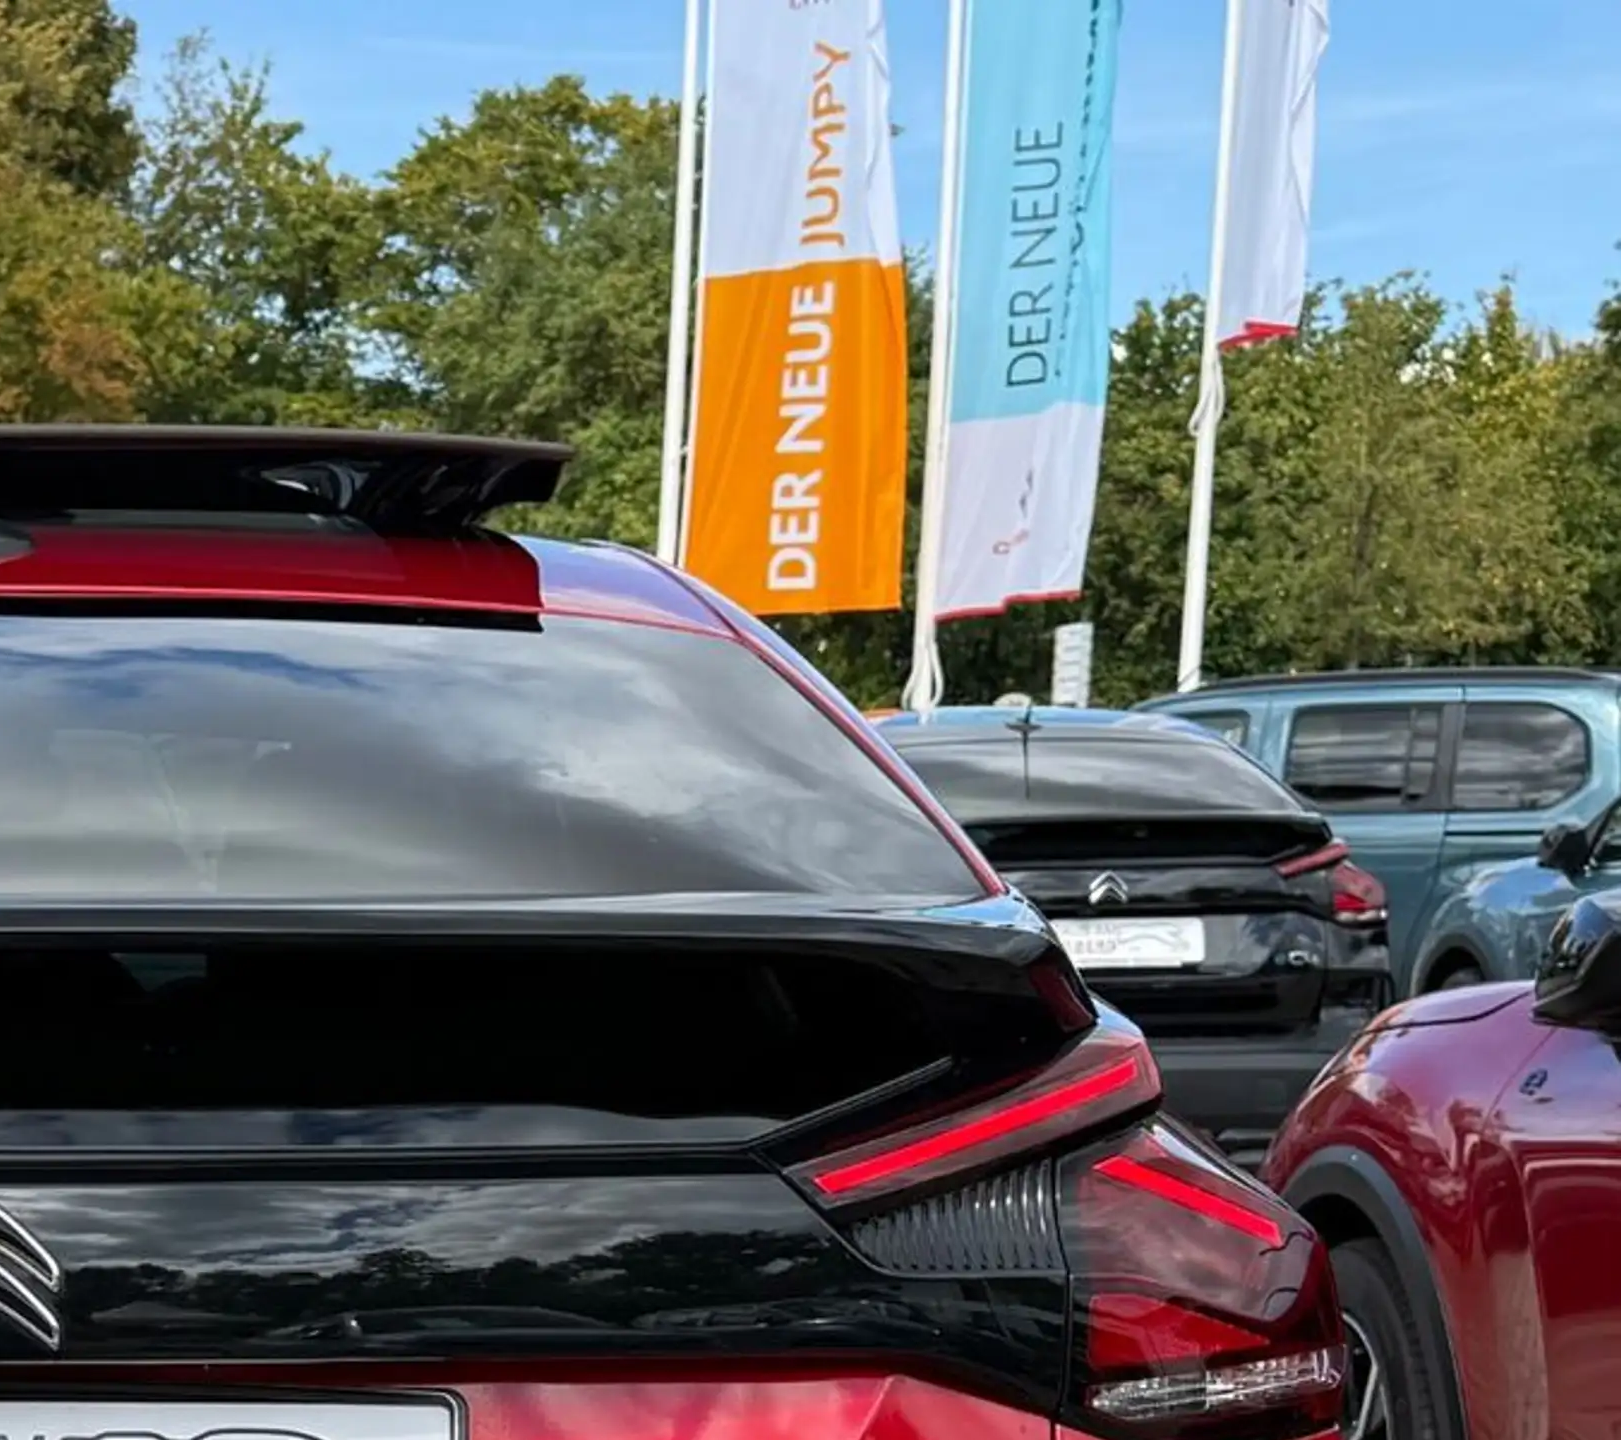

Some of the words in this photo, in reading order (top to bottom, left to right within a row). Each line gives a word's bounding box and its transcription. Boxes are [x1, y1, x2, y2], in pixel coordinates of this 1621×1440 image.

[799, 40, 851, 247] JUMPY
[1009, 120, 1064, 270] NEUE
[774, 279, 836, 453] NEUE
[1005, 282, 1055, 388] DER
[766, 467, 824, 591] DER
